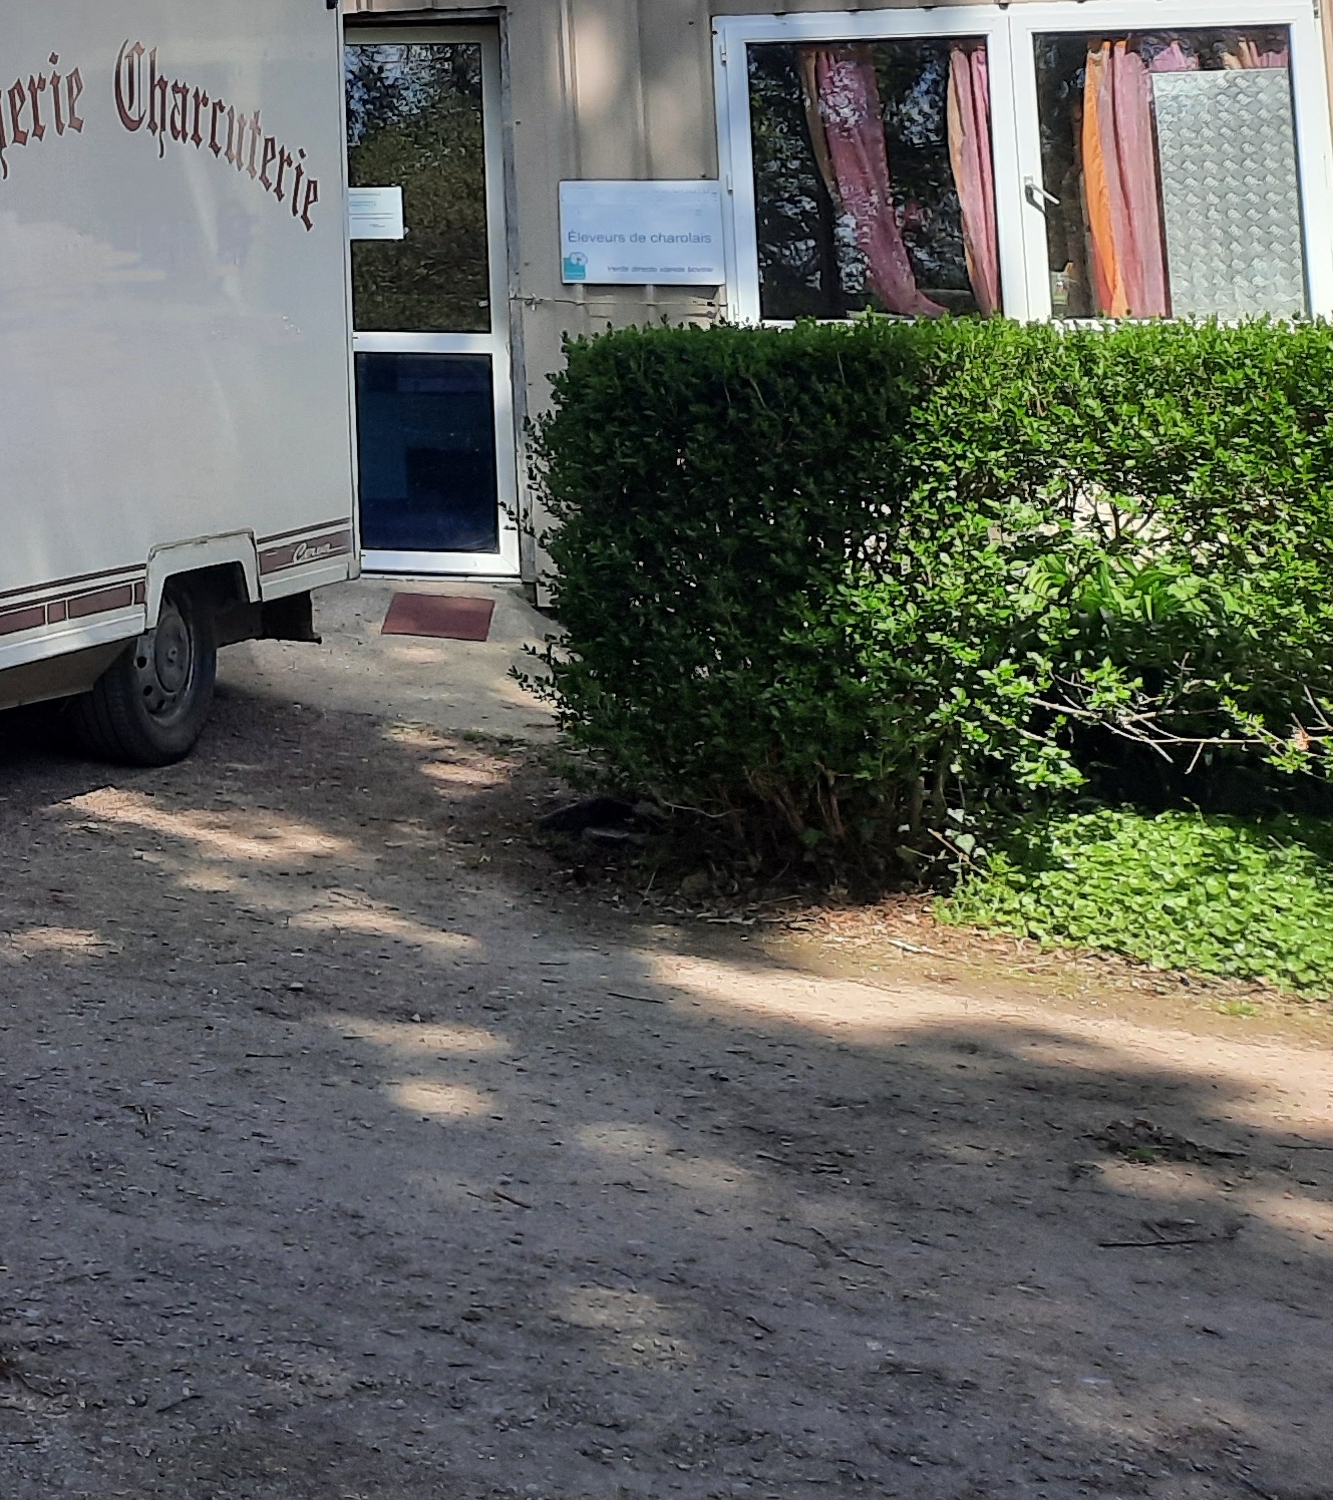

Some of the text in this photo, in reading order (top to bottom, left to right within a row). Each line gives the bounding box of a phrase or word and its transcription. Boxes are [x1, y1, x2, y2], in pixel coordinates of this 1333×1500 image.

[114, 39, 319, 232] Charcuterie
[567, 229, 712, 244] Éleveurs de charolais
